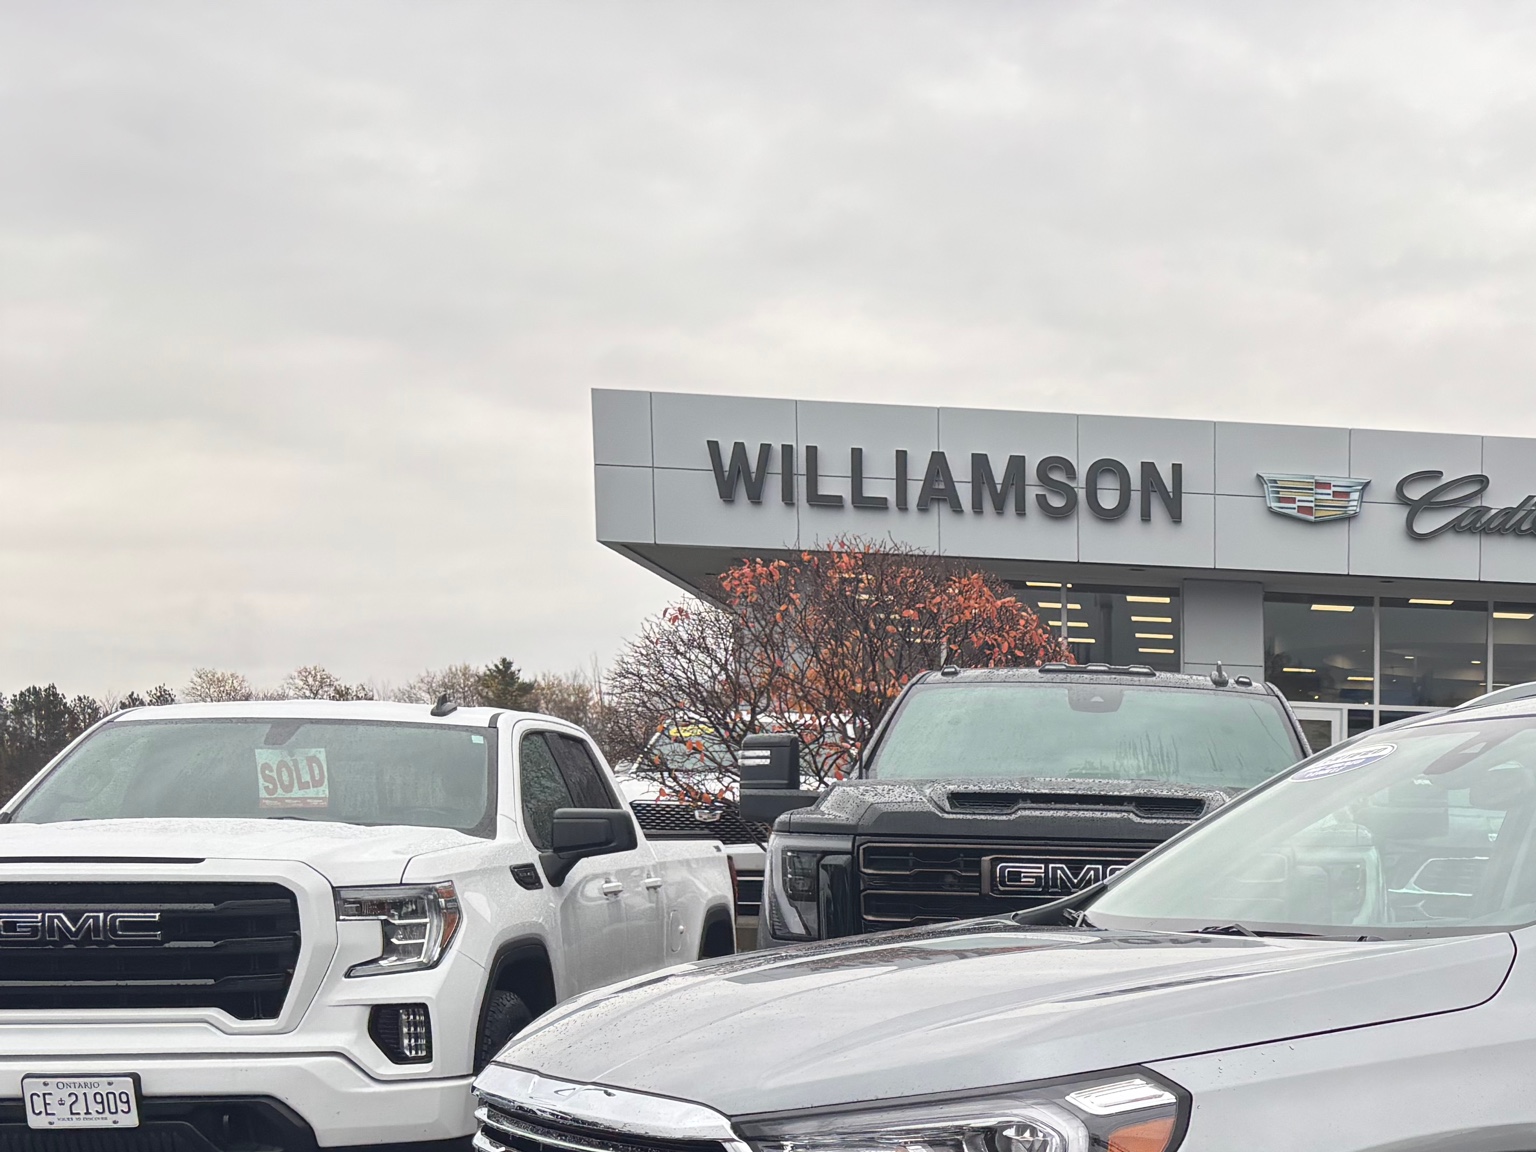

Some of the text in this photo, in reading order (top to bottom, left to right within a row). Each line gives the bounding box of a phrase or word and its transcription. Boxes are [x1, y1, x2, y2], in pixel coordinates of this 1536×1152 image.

[707, 439, 1183, 522] WILLIAMSON
[260, 755, 326, 797] SOLD
[0, 912, 161, 941] GMC
[56, 1081, 100, 1090] ONTARIO
[68, 1091, 131, 1116] 21909
